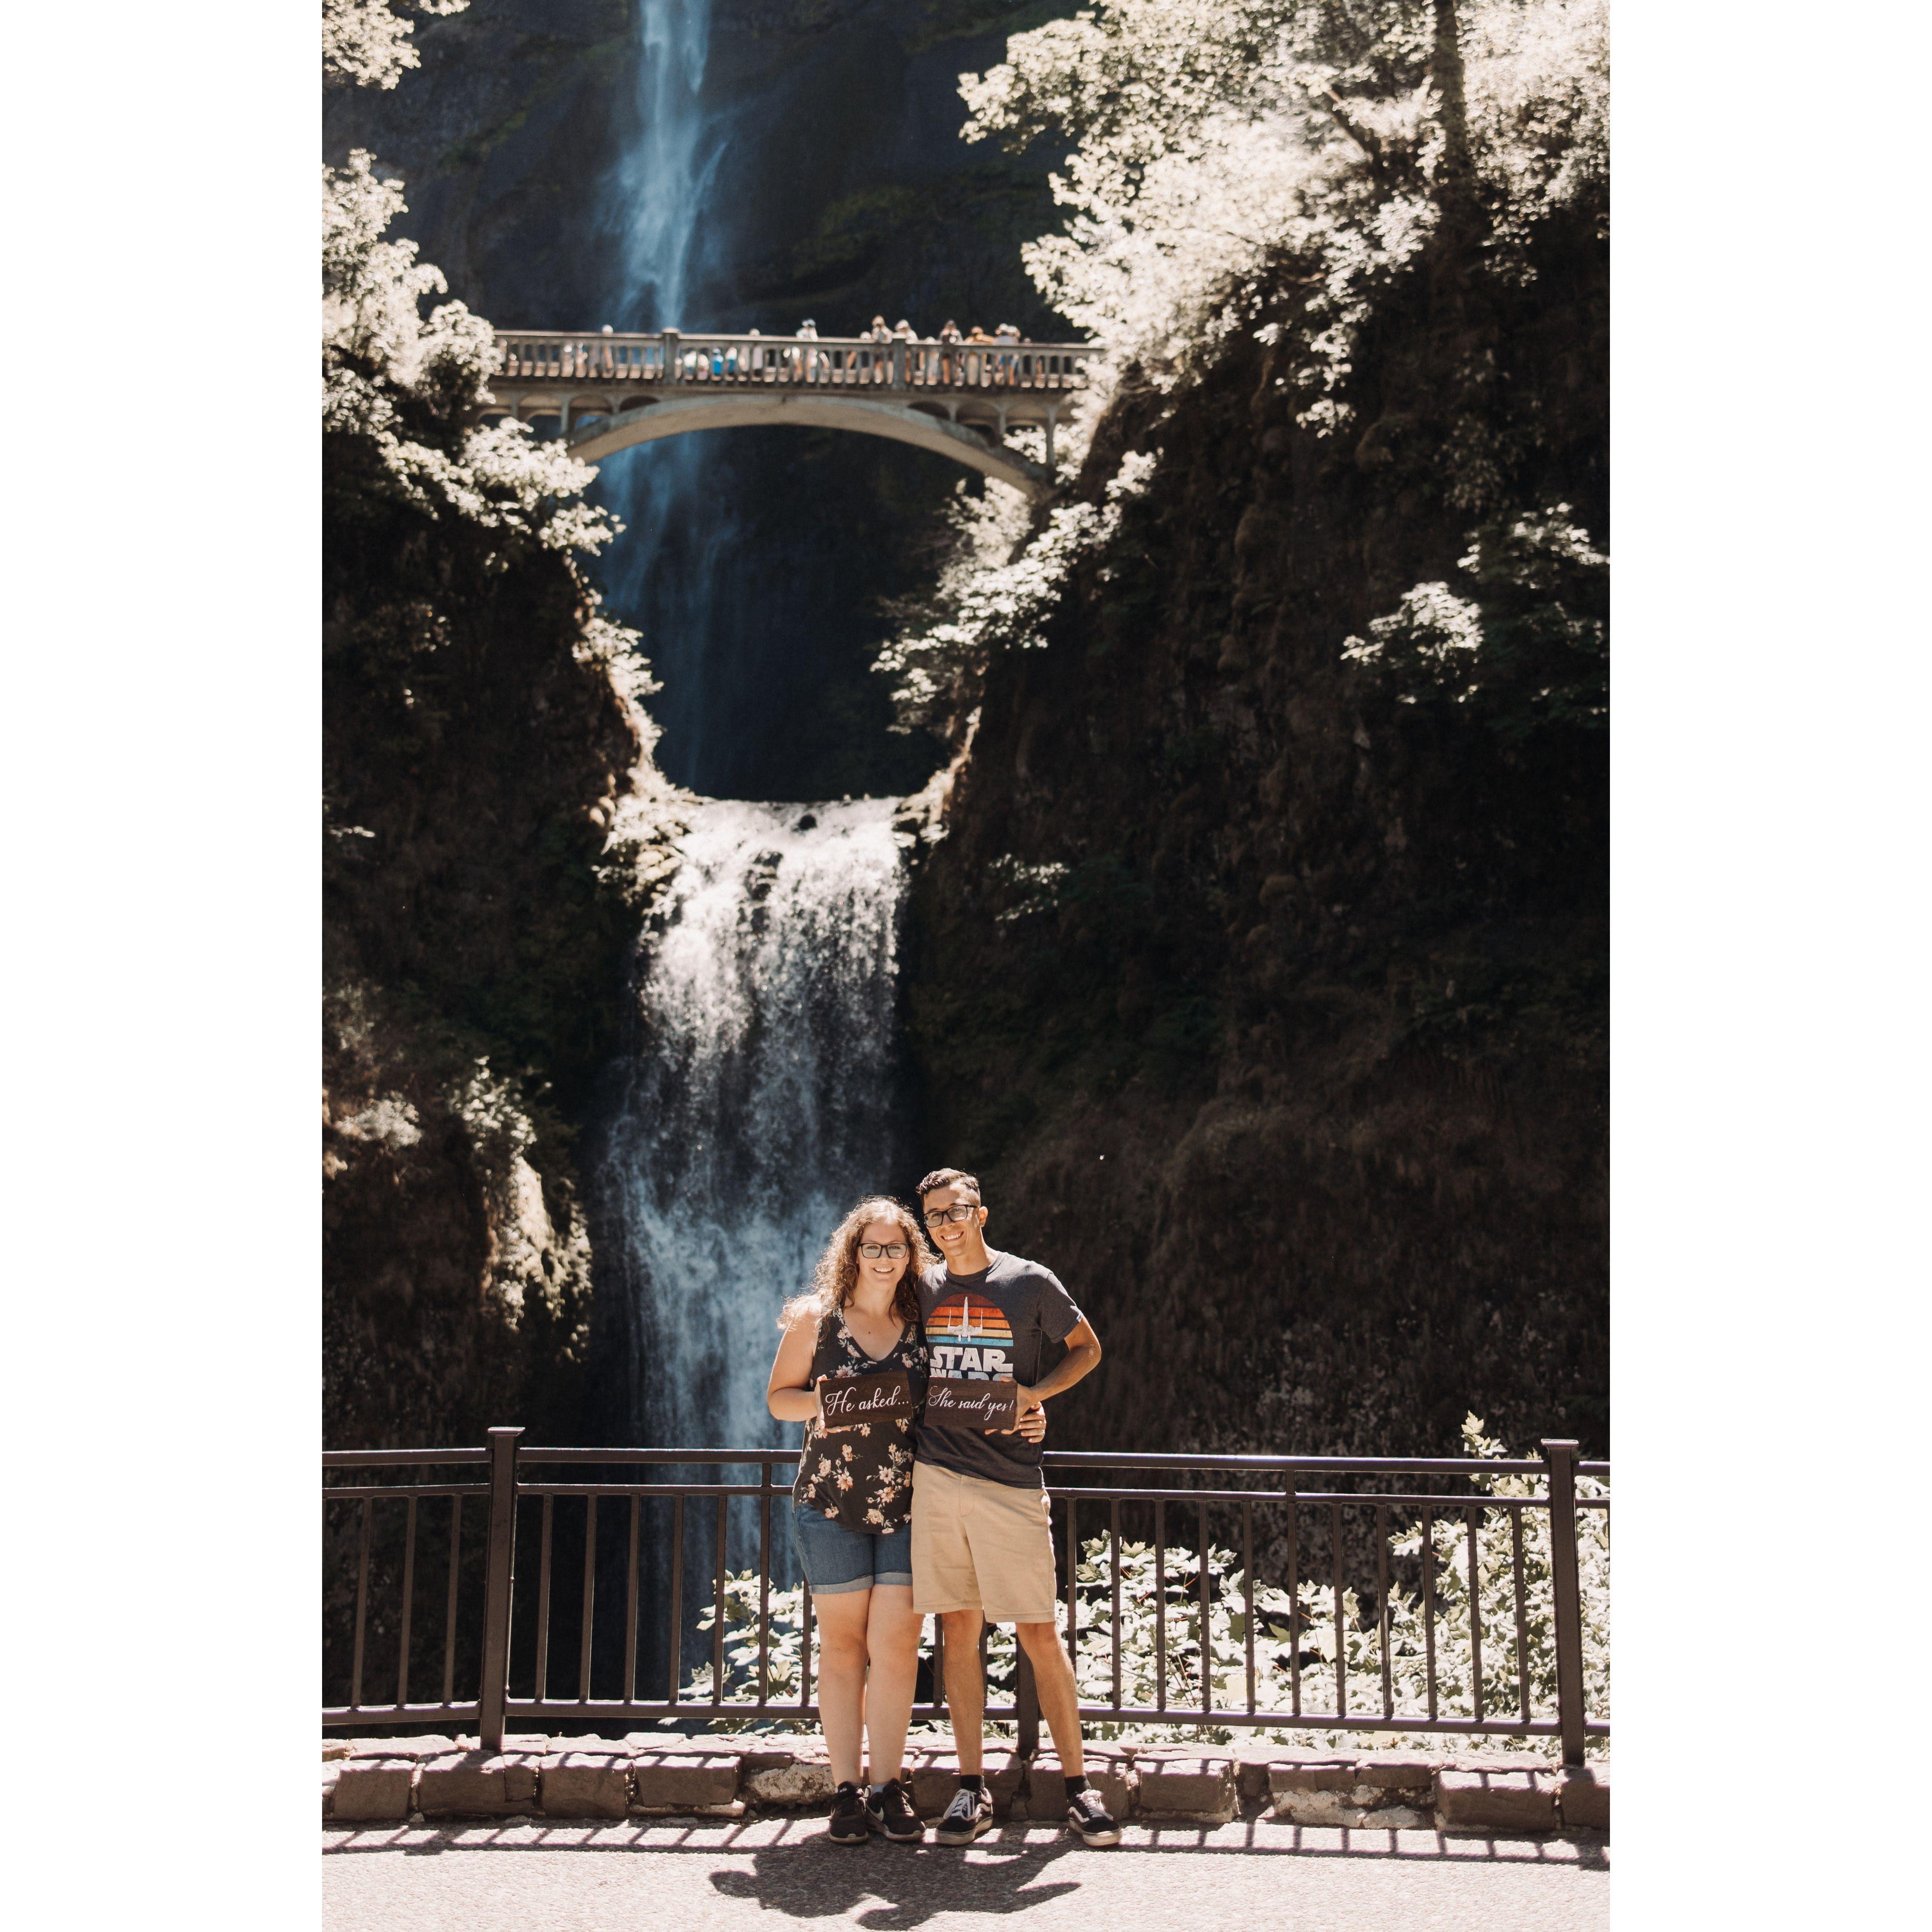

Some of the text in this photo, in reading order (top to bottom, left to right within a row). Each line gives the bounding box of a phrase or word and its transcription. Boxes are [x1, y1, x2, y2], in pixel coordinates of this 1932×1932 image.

[930, 1345, 1014, 1373] STAR
[825, 1385, 909, 1416] He asked...
[928, 1386, 1014, 1421] She said yes!
